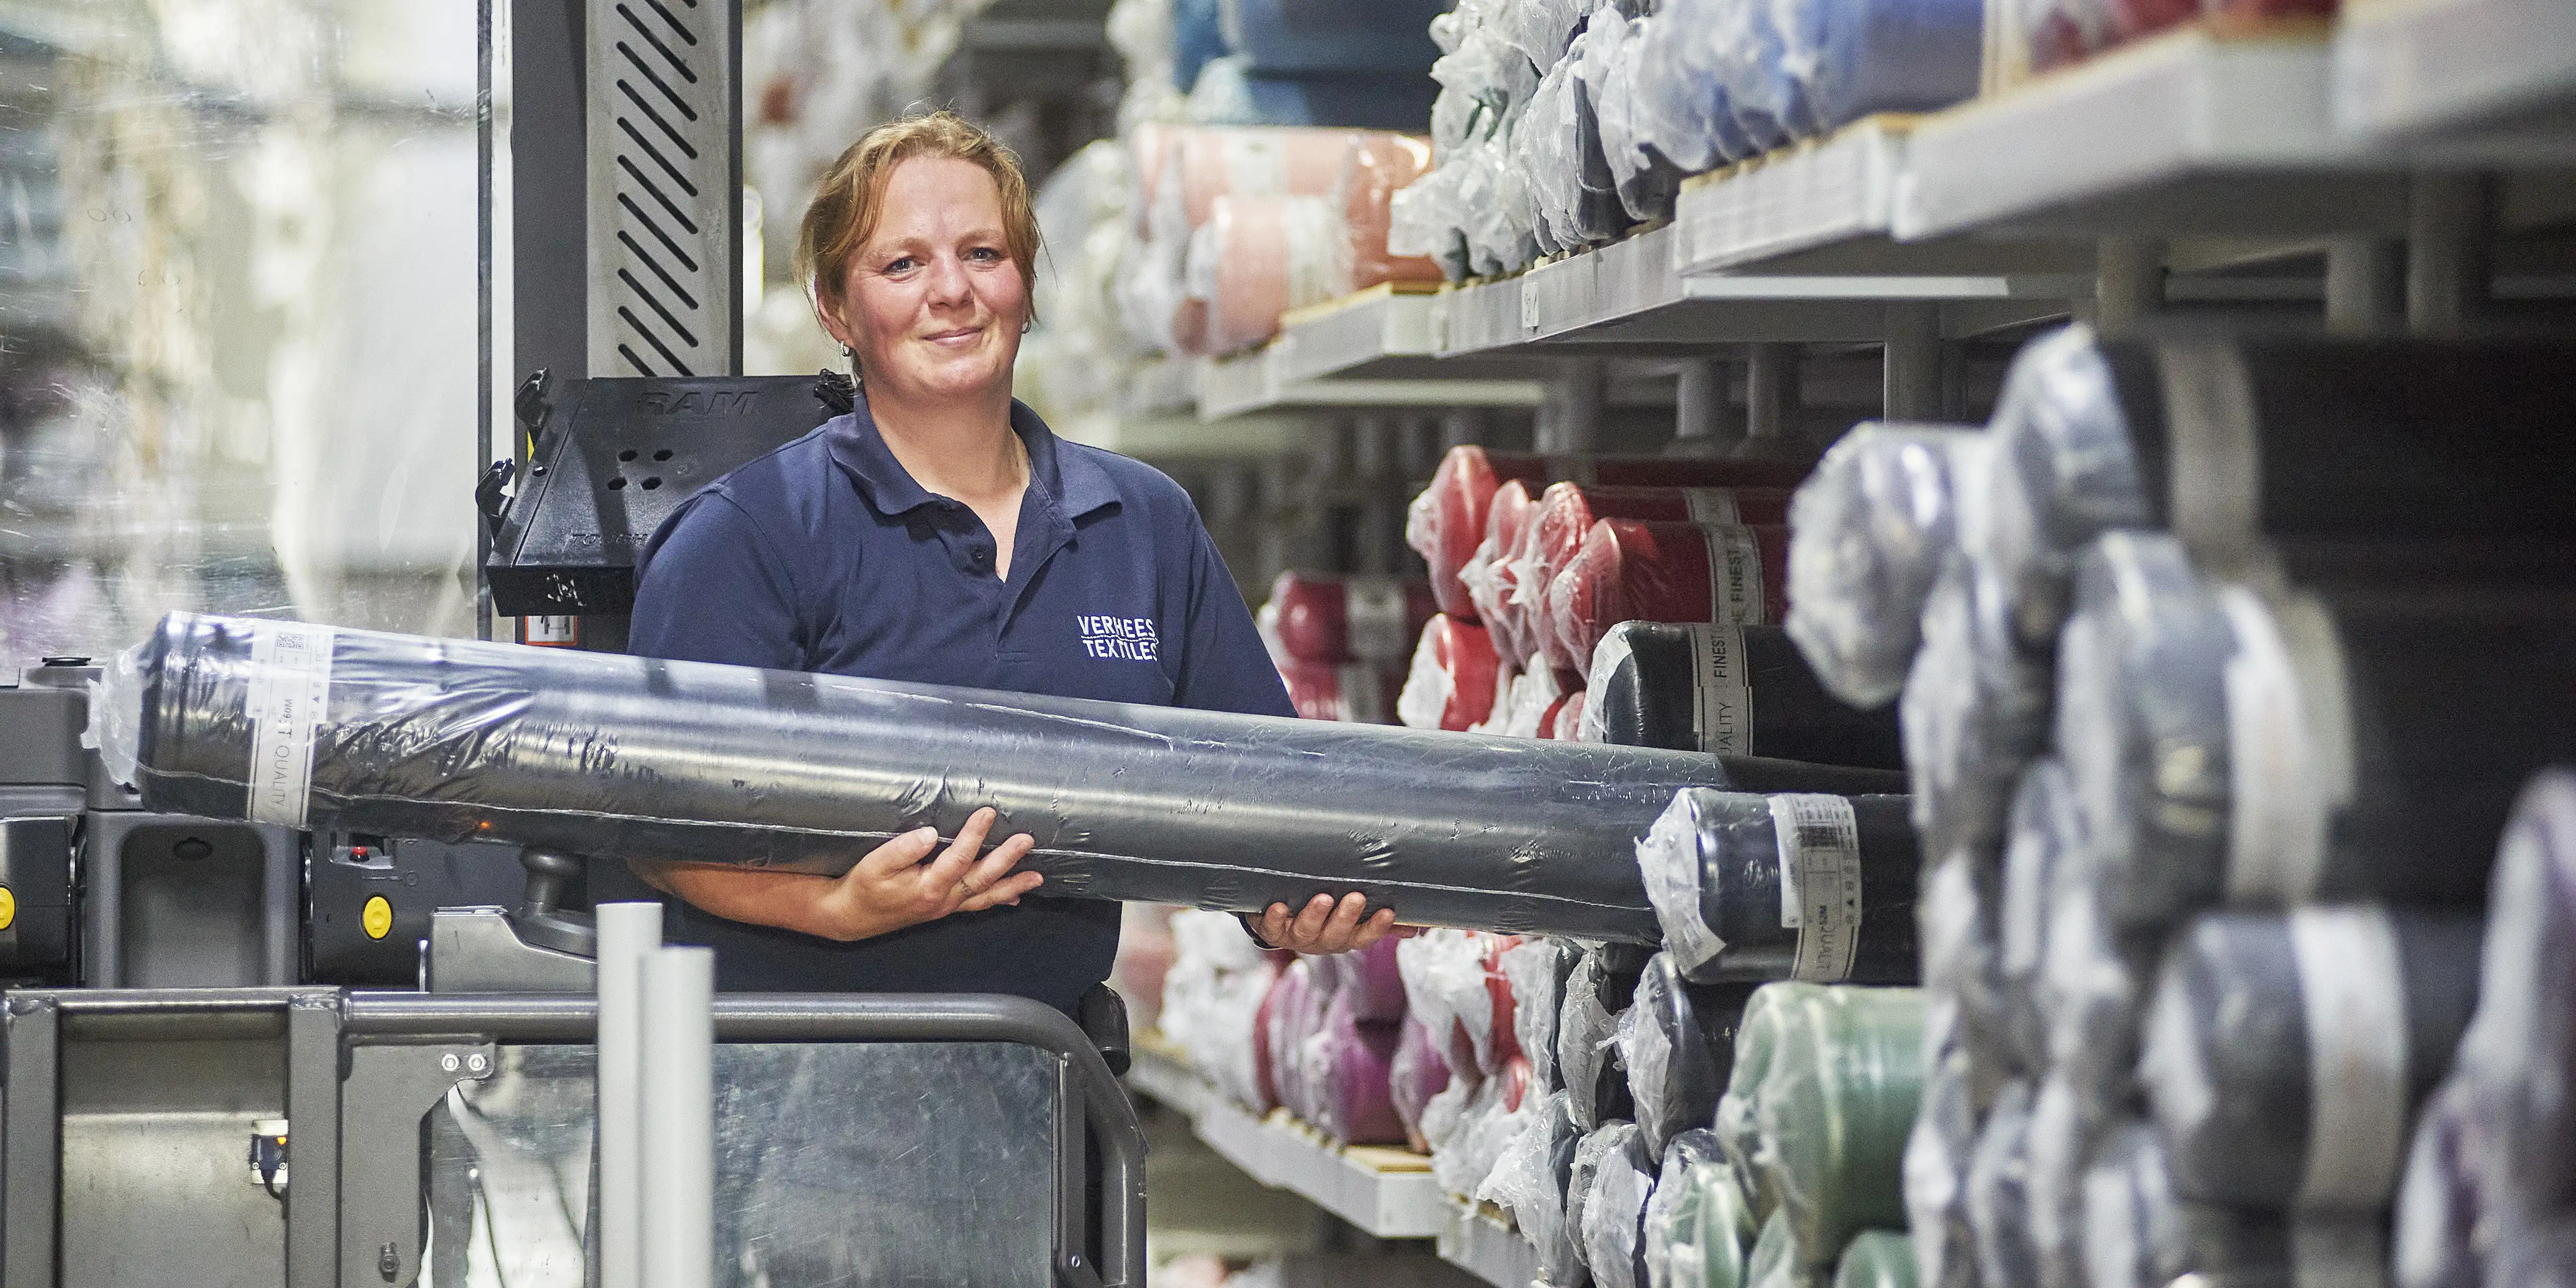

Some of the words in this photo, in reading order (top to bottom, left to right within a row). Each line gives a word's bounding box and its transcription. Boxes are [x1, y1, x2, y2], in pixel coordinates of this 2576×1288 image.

[637, 391, 760, 416] RAM
[1727, 549, 1744, 603] FINEST
[1076, 615, 1156, 639] VERHEES
[1082, 639, 1157, 662] TEXTILES
[1710, 634, 1729, 678] FINEST
[1718, 702, 1734, 755] UALITY
[271, 744, 290, 807] QUALITY
